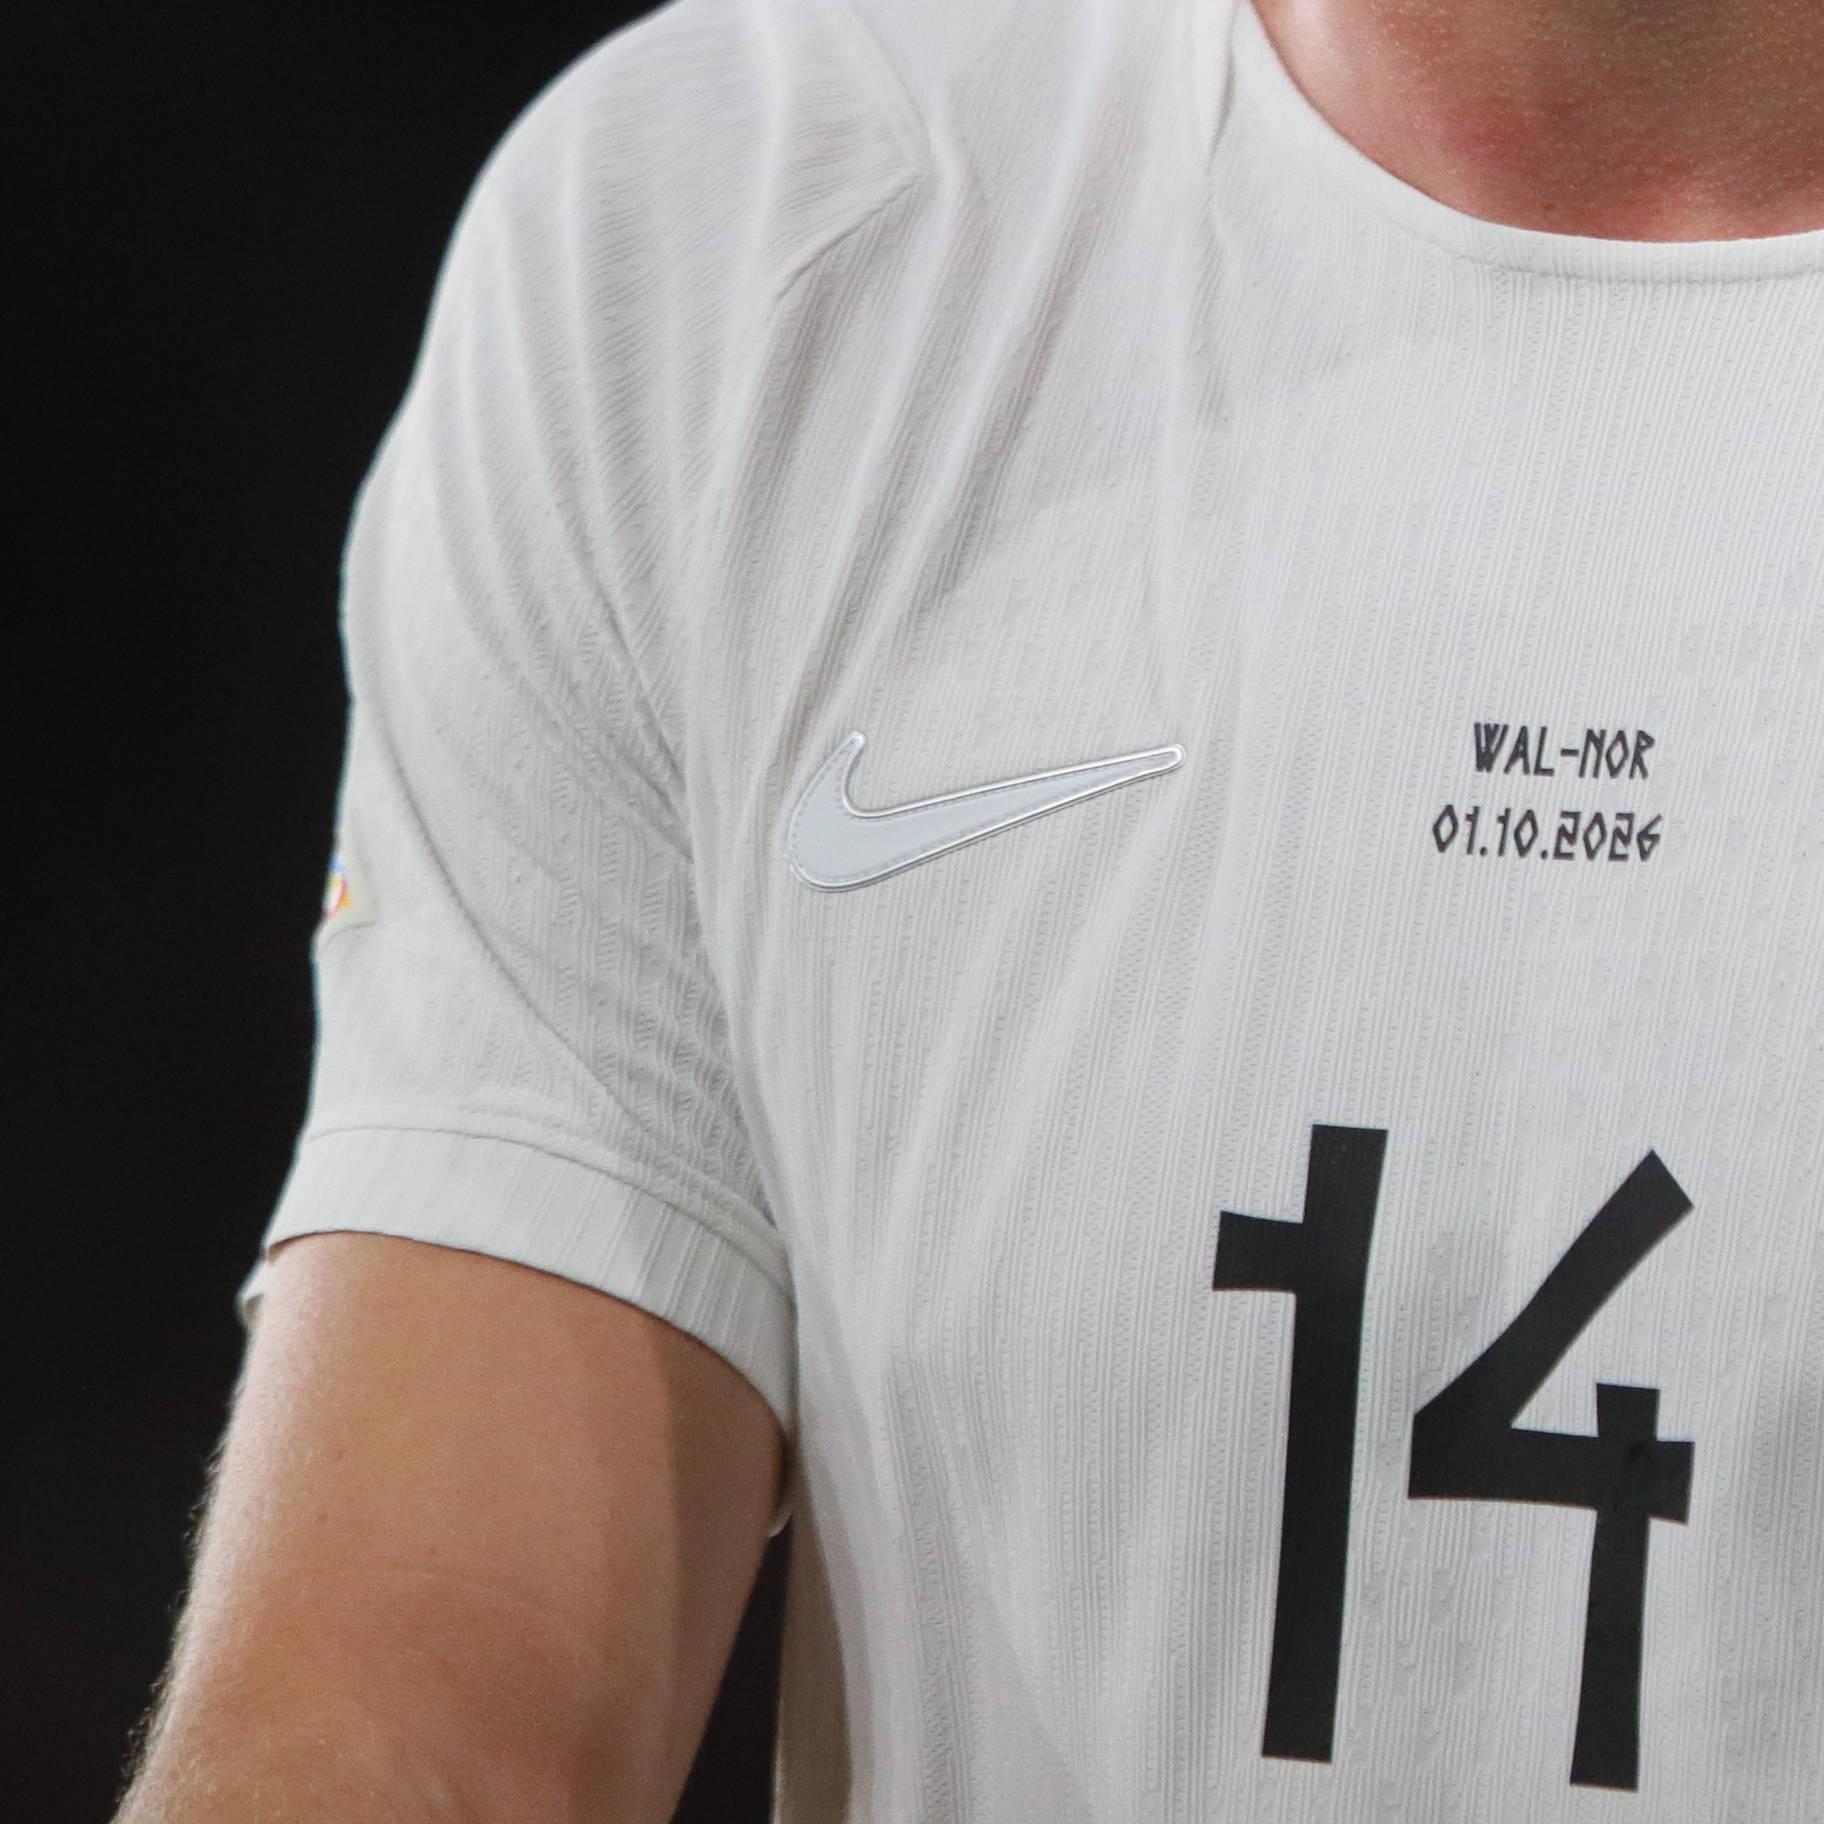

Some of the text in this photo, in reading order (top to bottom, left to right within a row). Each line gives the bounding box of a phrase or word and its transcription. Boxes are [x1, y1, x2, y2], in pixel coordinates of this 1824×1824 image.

[1473, 722, 1655, 779] WAL-NOR
[1432, 804, 1663, 861] 01.10.2026
[1212, 1123, 1695, 1792] 14
